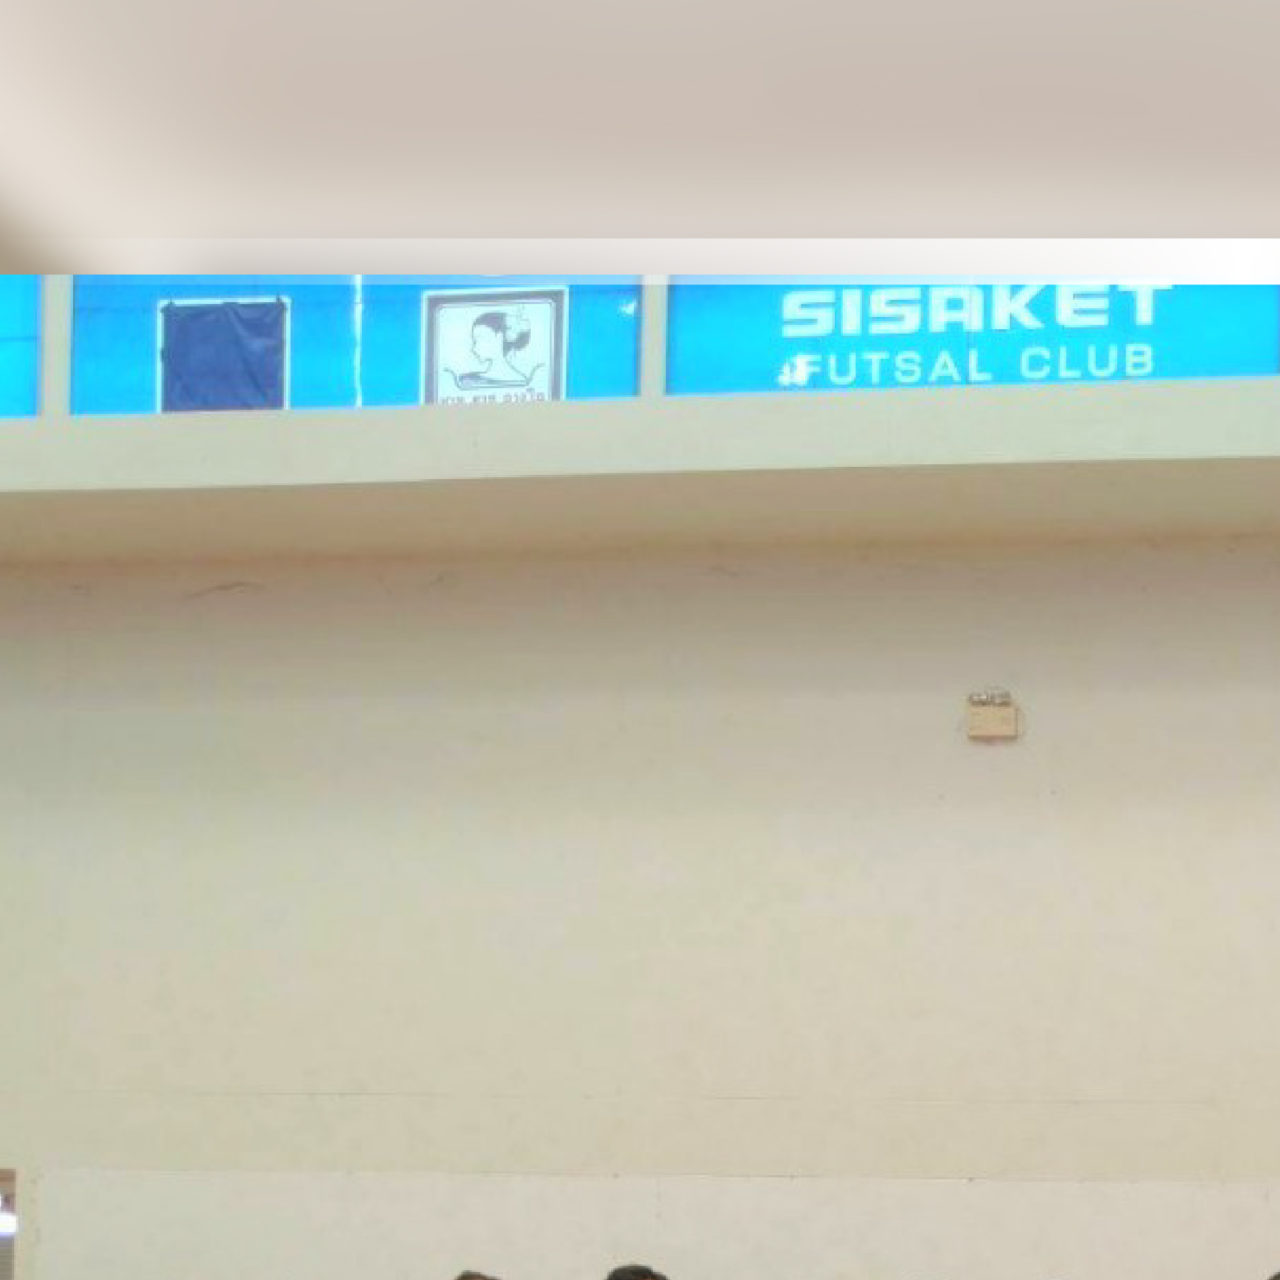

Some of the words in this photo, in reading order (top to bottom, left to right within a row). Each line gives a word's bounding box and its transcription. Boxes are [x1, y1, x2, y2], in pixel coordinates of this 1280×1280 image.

[782, 282, 1173, 338] SISAKET
[793, 349, 992, 387] FUTSAL
[1020, 343, 1155, 380] CLUB
